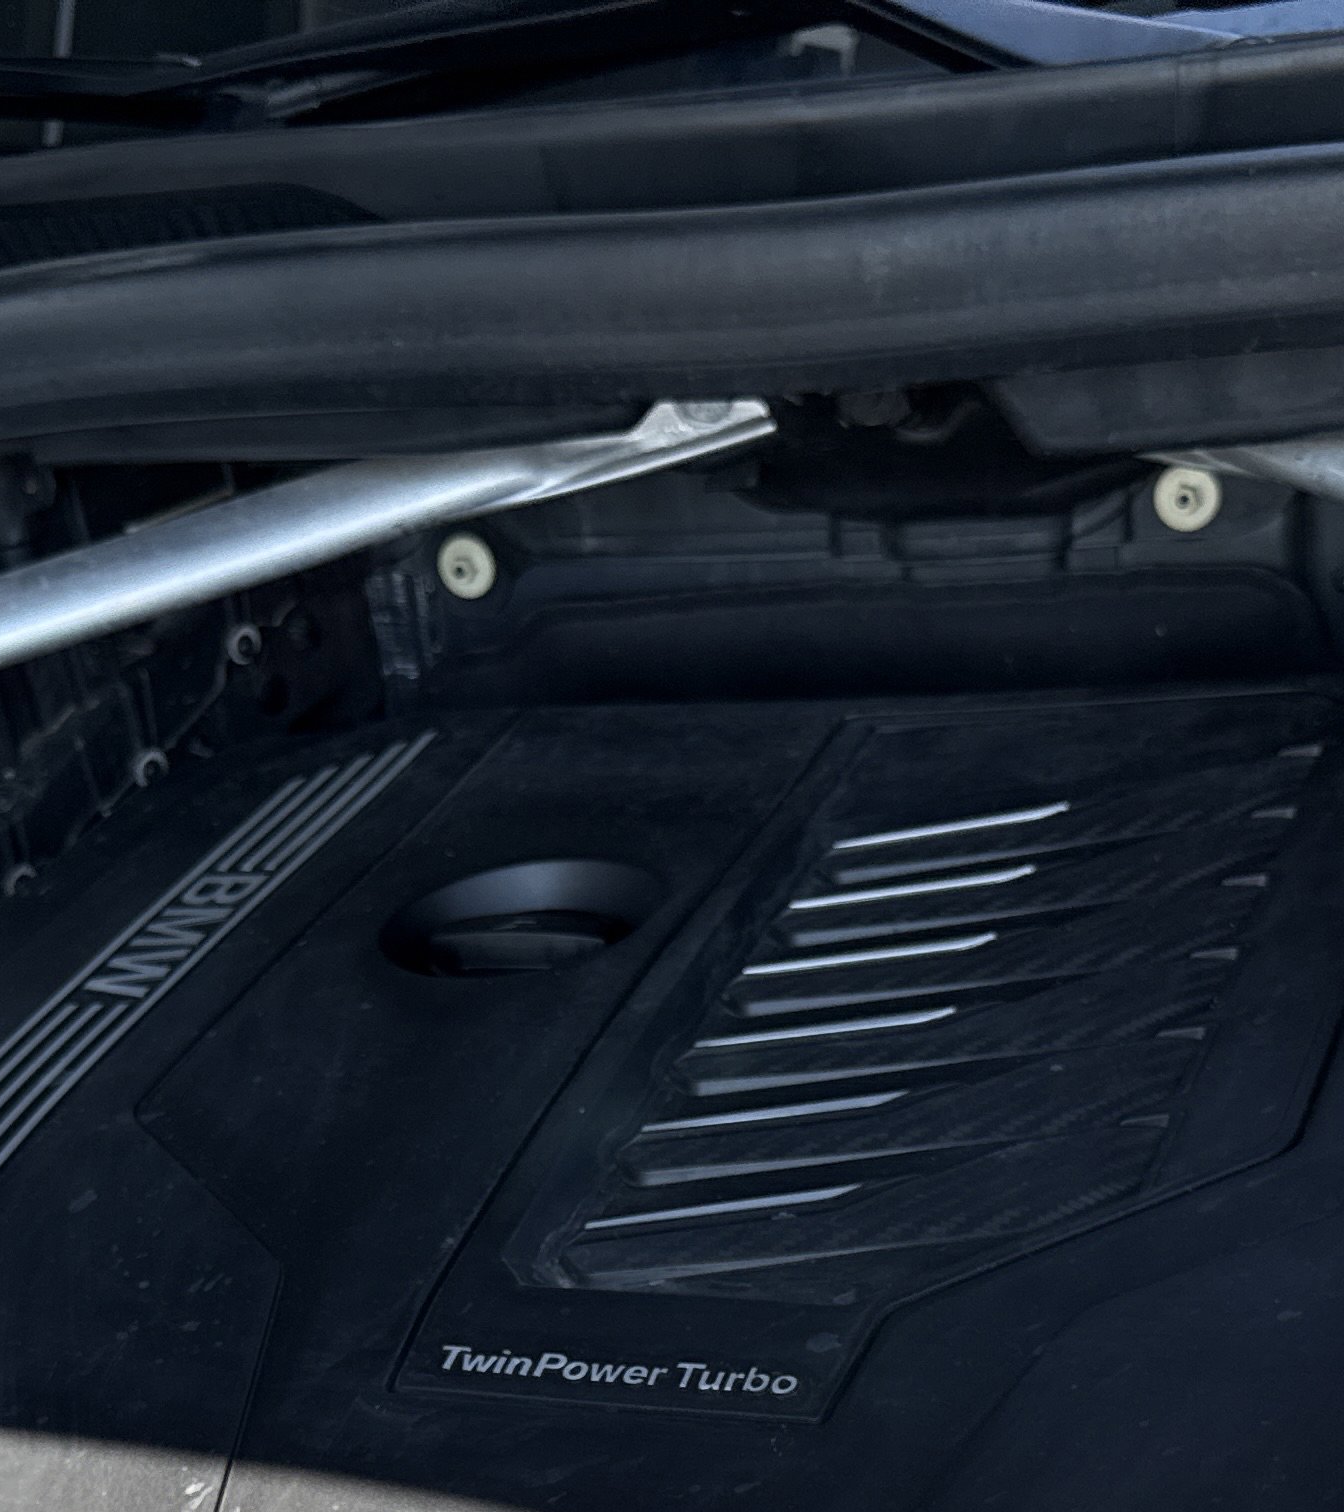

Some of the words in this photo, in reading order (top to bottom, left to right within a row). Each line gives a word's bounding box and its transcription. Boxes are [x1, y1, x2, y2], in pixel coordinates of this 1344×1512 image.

[83, 873, 272, 999] BMW
[440, 1344, 668, 1387] TwinPower
[676, 1361, 799, 1395] Turbo
